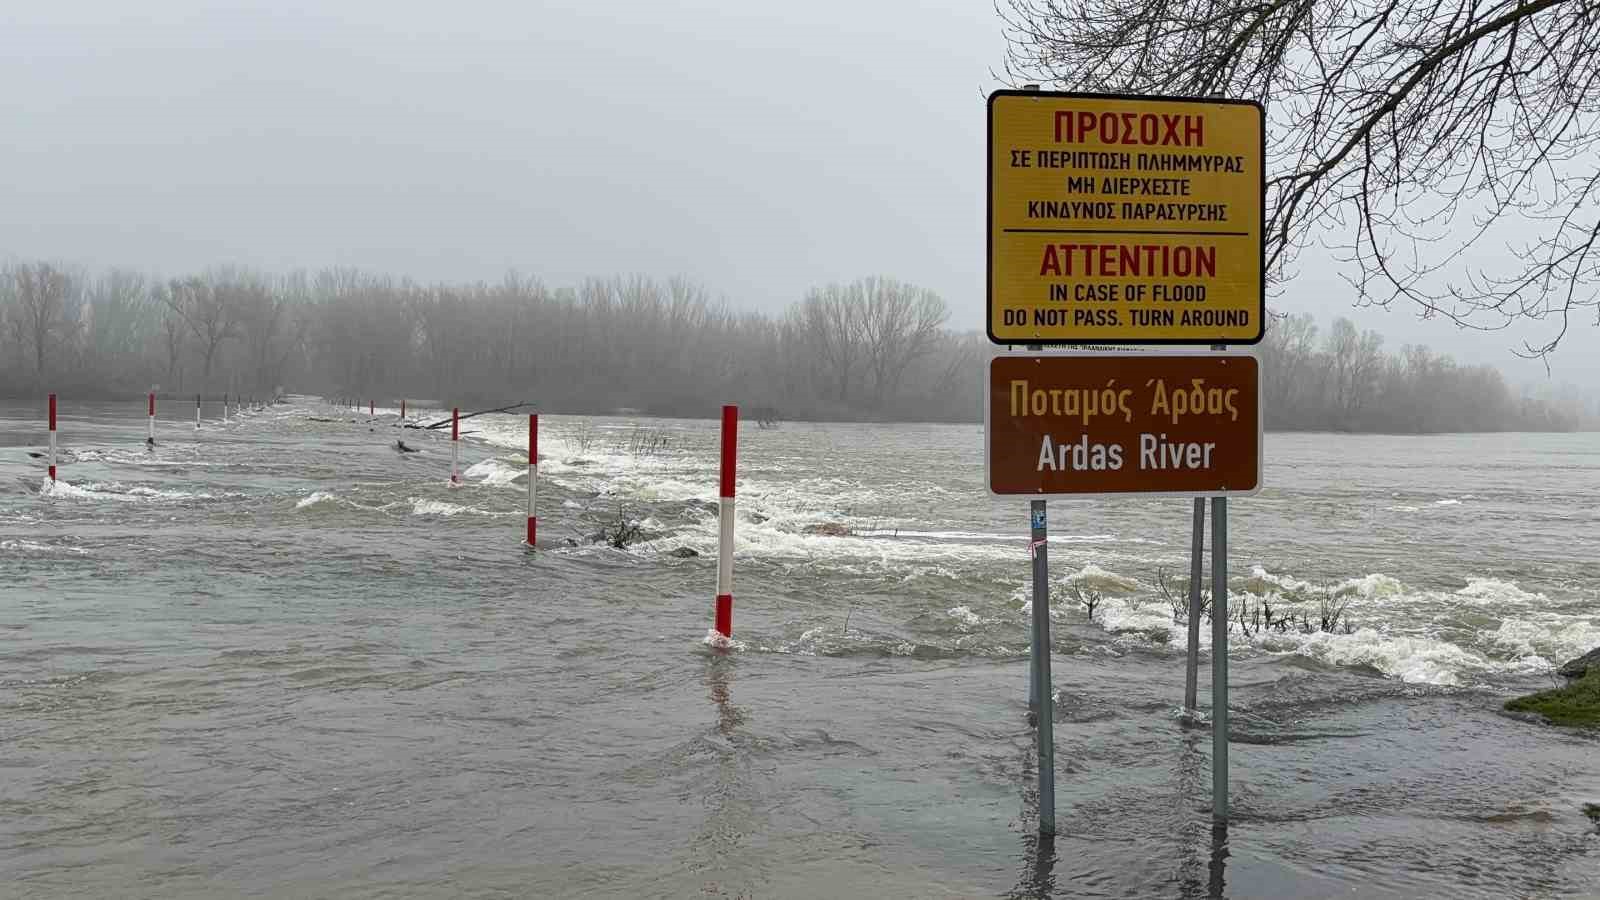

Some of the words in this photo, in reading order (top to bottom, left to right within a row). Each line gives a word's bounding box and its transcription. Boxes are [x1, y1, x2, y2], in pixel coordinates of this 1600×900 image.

[1054, 111, 1204, 147] ΠΡΟΣΟΧΗ
[1011, 150, 1031, 168] ΣΕ
[1037, 151, 1131, 170] ΠΕΡΙΠΤΩΣΗ
[1137, 154, 1245, 173] ΠΛΗΜΜΥΡΑΣ
[1067, 176, 1095, 194] ΜΗ
[1101, 178, 1190, 196] ΔΙΕΡΧΕΣΤΕ
[1028, 201, 1116, 219] ΚΙΝΔΥΝΟΣ
[1122, 203, 1228, 221] ΠΑΡΑΣΥΡΣΗΣ
[1040, 244, 1216, 278] ATTENTION
[1050, 284, 1068, 302] IN
[1074, 284, 1119, 302] CASE
[1125, 284, 1147, 302] OF
[1152, 284, 1207, 302] FLOOD
[1004, 309, 1027, 327] DO
[1034, 309, 1067, 327] NOT
[1074, 309, 1123, 327] PASS.
[1130, 309, 1174, 327] TURN
[1180, 309, 1249, 327] AROUND
[1010, 378, 1134, 426] Ποταμός
[1146, 378, 1240, 425] Άρδας
[1037, 433, 1125, 472] Ardas
[1140, 432, 1216, 469] River
